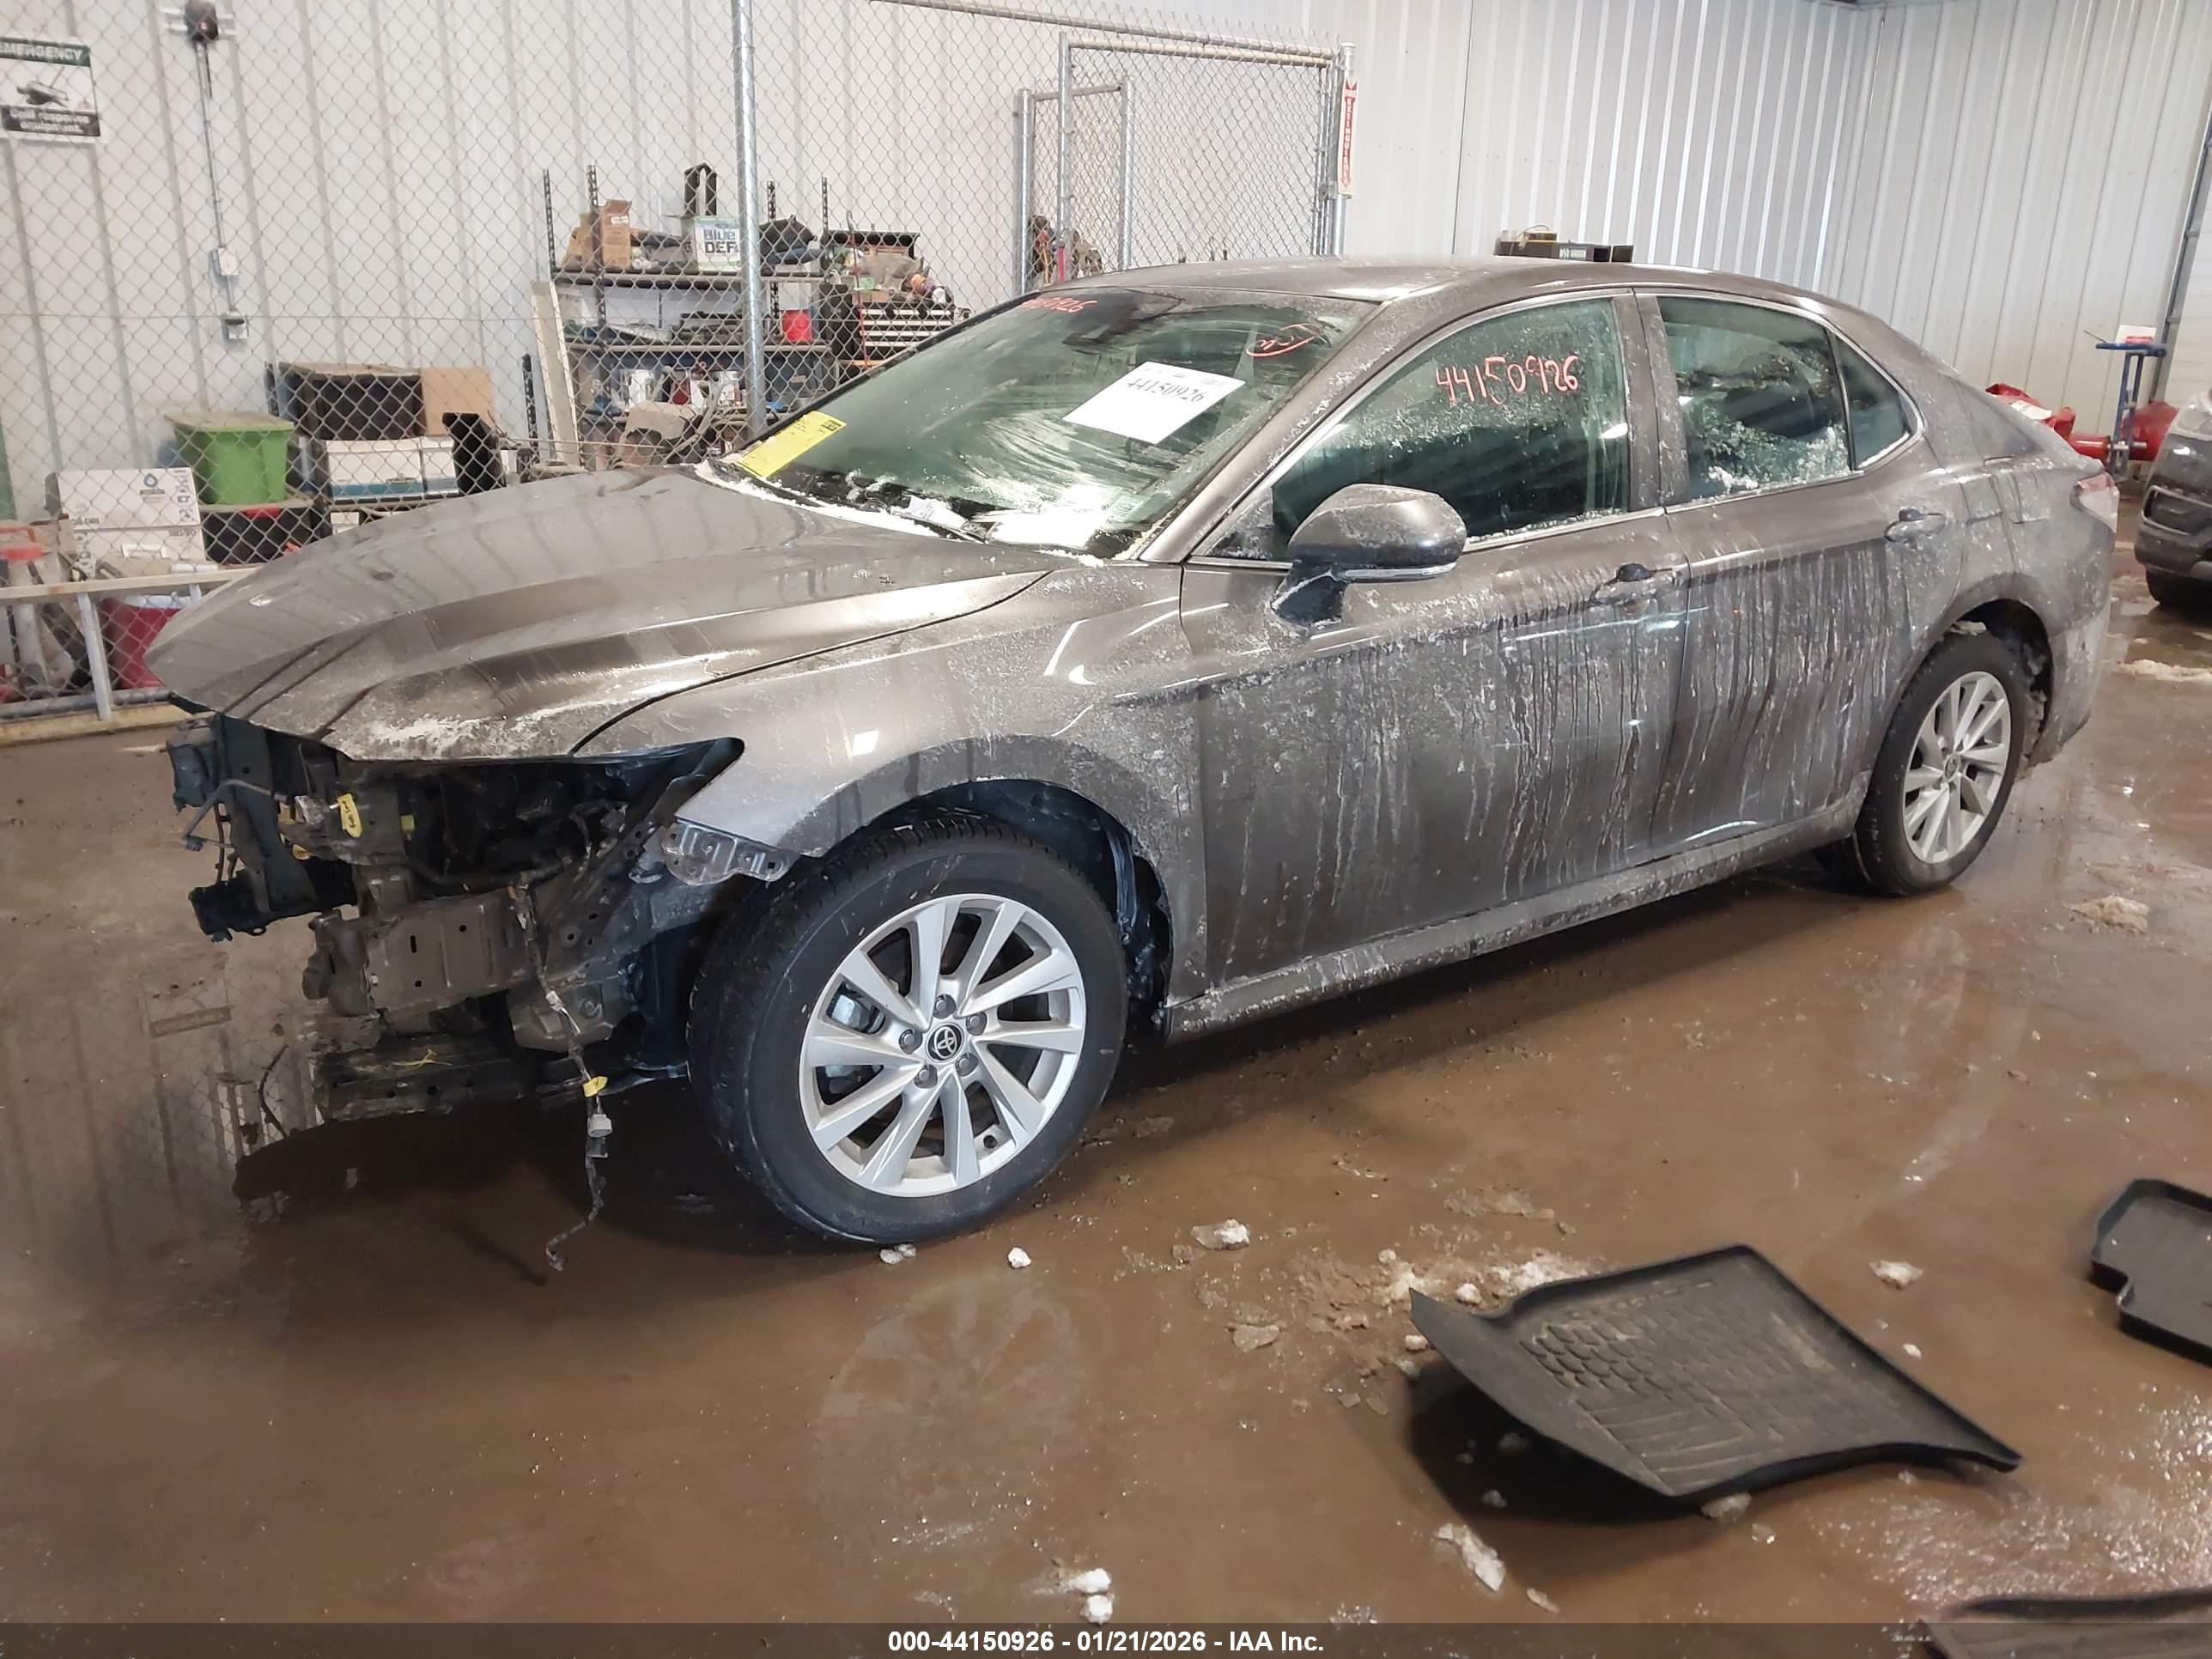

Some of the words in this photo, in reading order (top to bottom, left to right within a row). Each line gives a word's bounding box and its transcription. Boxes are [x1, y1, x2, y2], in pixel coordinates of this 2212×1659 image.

[705, 241, 736, 253] DEF
[1127, 378, 1205, 403] 44150926
[1436, 355, 1579, 407] 44150926
